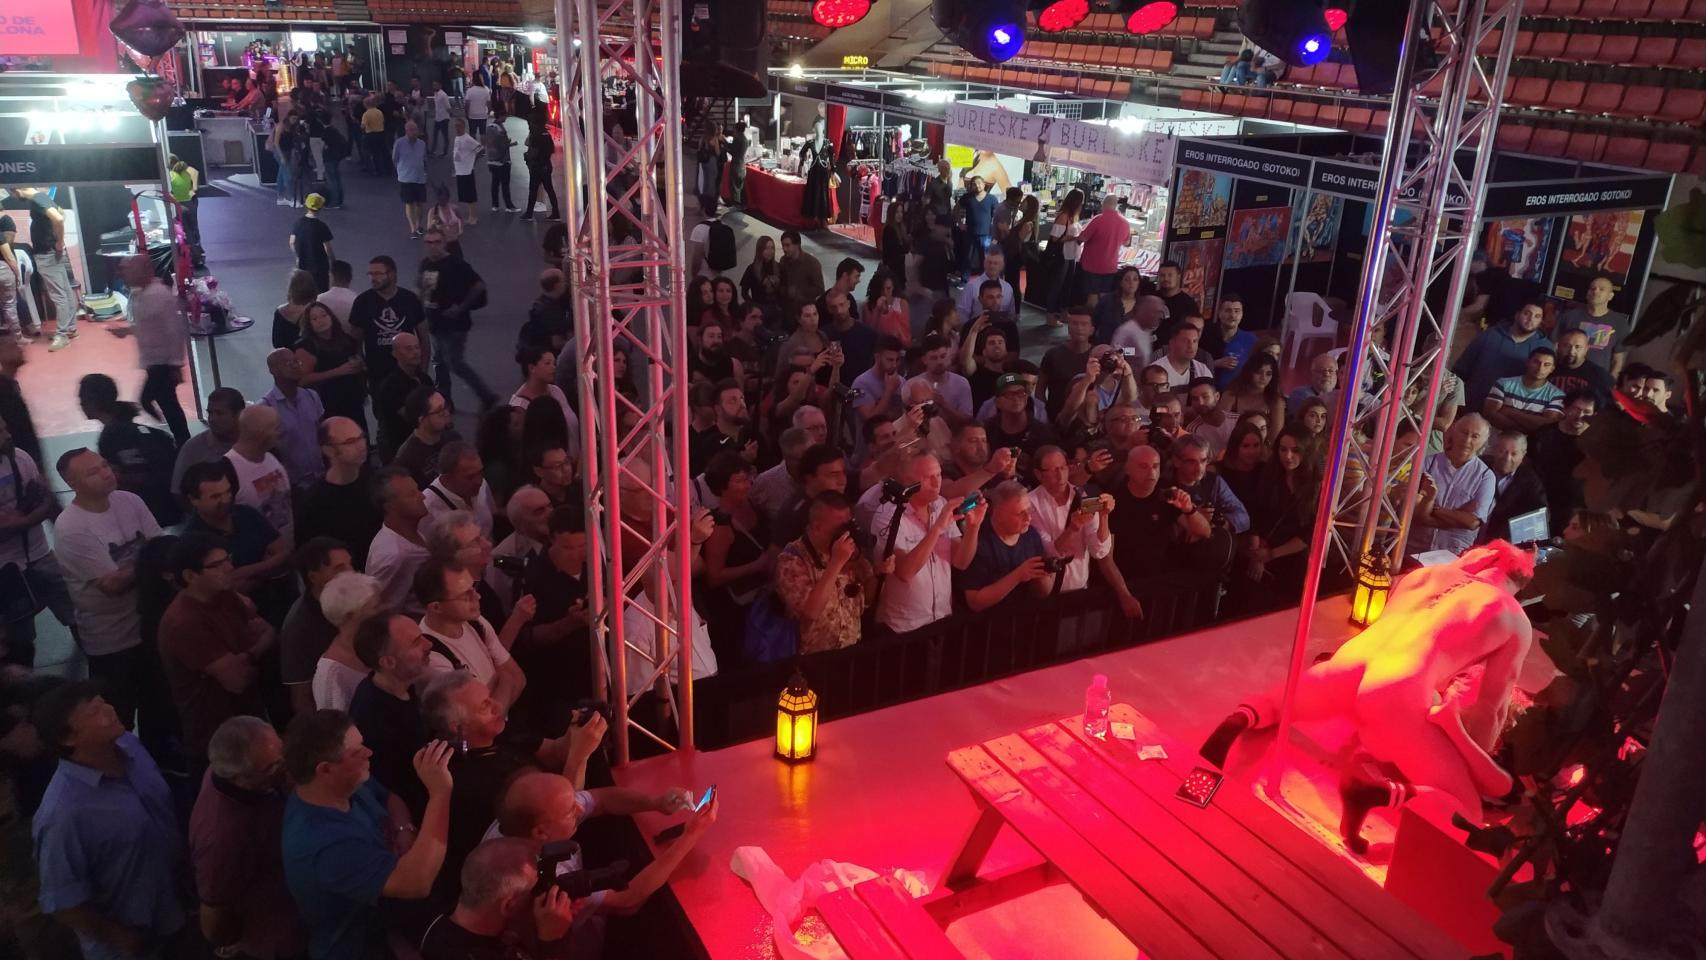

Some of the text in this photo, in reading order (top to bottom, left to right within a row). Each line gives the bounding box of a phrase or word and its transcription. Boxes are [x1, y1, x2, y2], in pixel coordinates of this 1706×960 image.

[12, 16, 36, 24] DE
[843, 55, 869, 65] MICRO
[1060, 122, 1166, 164] BURLESKE
[1185, 149, 1301, 177] EROS INTERROGADO (SOTOKO)
[1321, 172, 1346, 185] EROS
[1525, 195, 1547, 206] EROS
[1547, 192, 1599, 205] INTERROGADO
